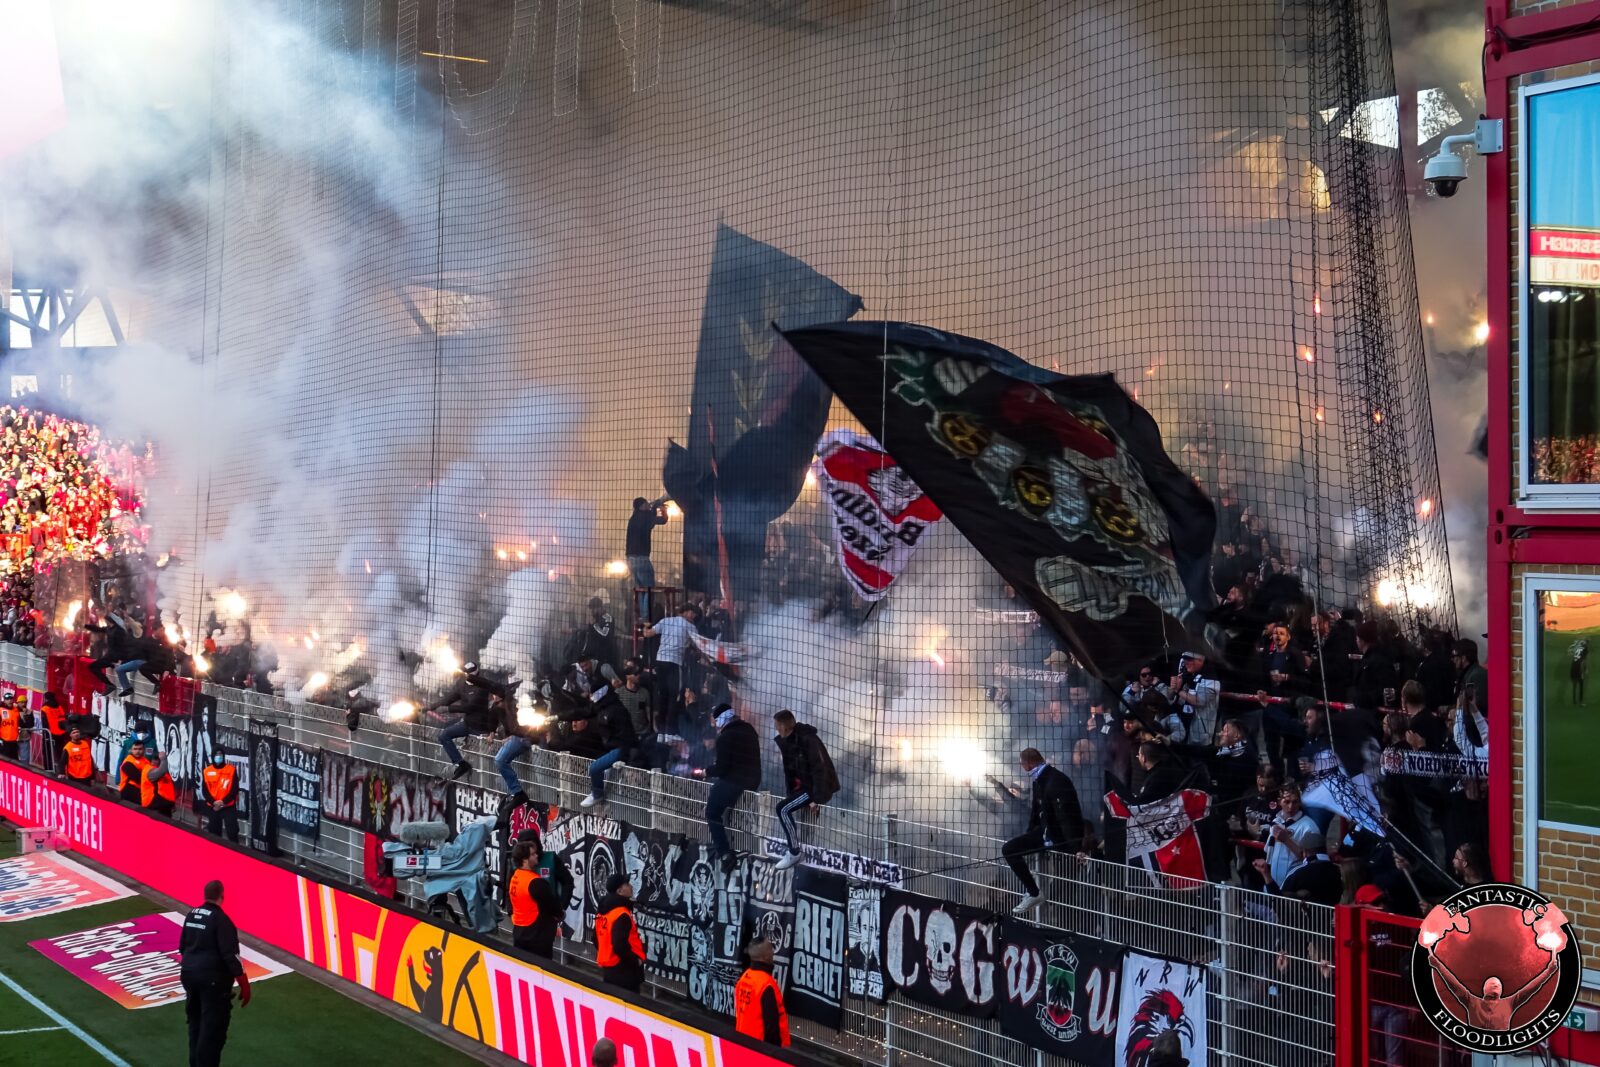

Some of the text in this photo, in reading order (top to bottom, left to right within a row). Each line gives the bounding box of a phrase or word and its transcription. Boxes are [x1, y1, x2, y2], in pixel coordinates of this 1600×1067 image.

[36, 779, 102, 852] FÖRSTEREI
[794, 898, 844, 964] RIED
[792, 951, 843, 1000] GEBIET
